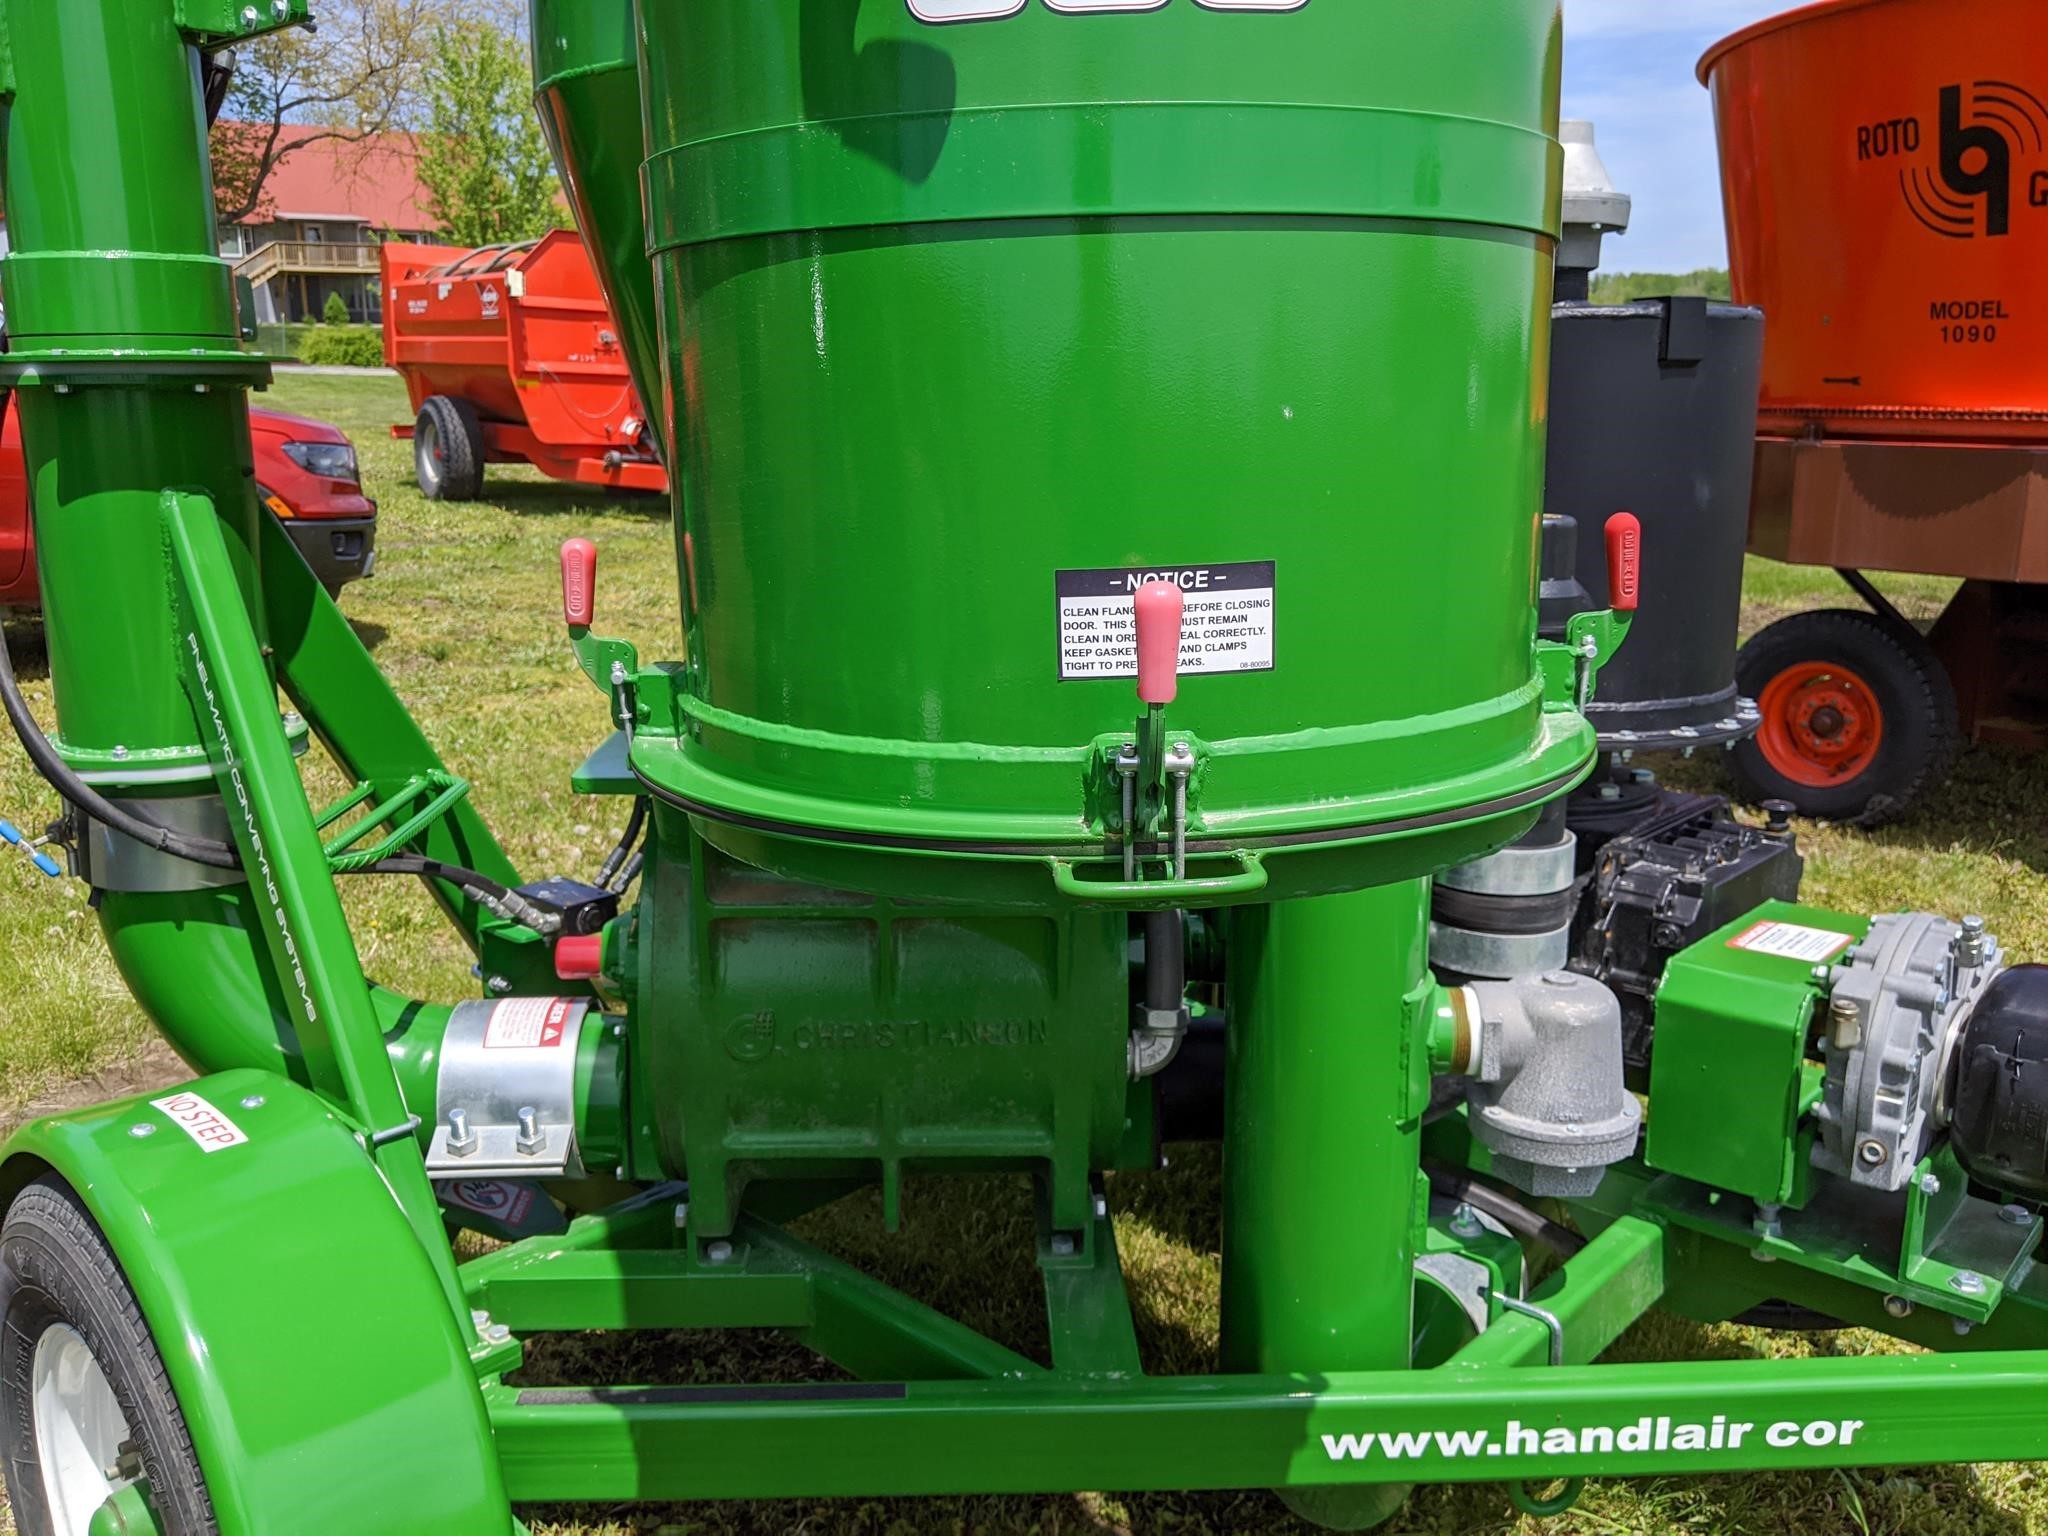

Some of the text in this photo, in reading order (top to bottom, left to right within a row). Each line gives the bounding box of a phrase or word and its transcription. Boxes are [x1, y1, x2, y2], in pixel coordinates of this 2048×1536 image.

[1857, 116, 1920, 161] ROTO
[1930, 300, 2009, 320] MODEL
[1941, 324, 1997, 343] 1090
[1063, 607, 1099, 617] CLEAN
[1102, 606, 1136, 616] FLANG
[1225, 599, 1270, 610] CLOSING
[1063, 621, 1098, 630] DOOR.
[1103, 620, 1127, 629] THIS
[1208, 614, 1248, 625] REMAIN
[1064, 626, 1266, 644] CLEAN IN ORD EAL CORRECTLY.
[1064, 648, 1092, 658] KEEP
[1180, 644, 1202, 654] AND
[1205, 641, 1247, 652] CLAMPS
[1064, 662, 1096, 671] TIGHT
[1098, 661, 1113, 670] TO
[1176, 657, 1205, 667] EAKS.
[188, 632, 317, 1023] PNEUMATIC CONVEYING SYSTEMS
[181, 1110, 236, 1143] STEP
[1320, 1415, 1754, 1460] www.handlair
